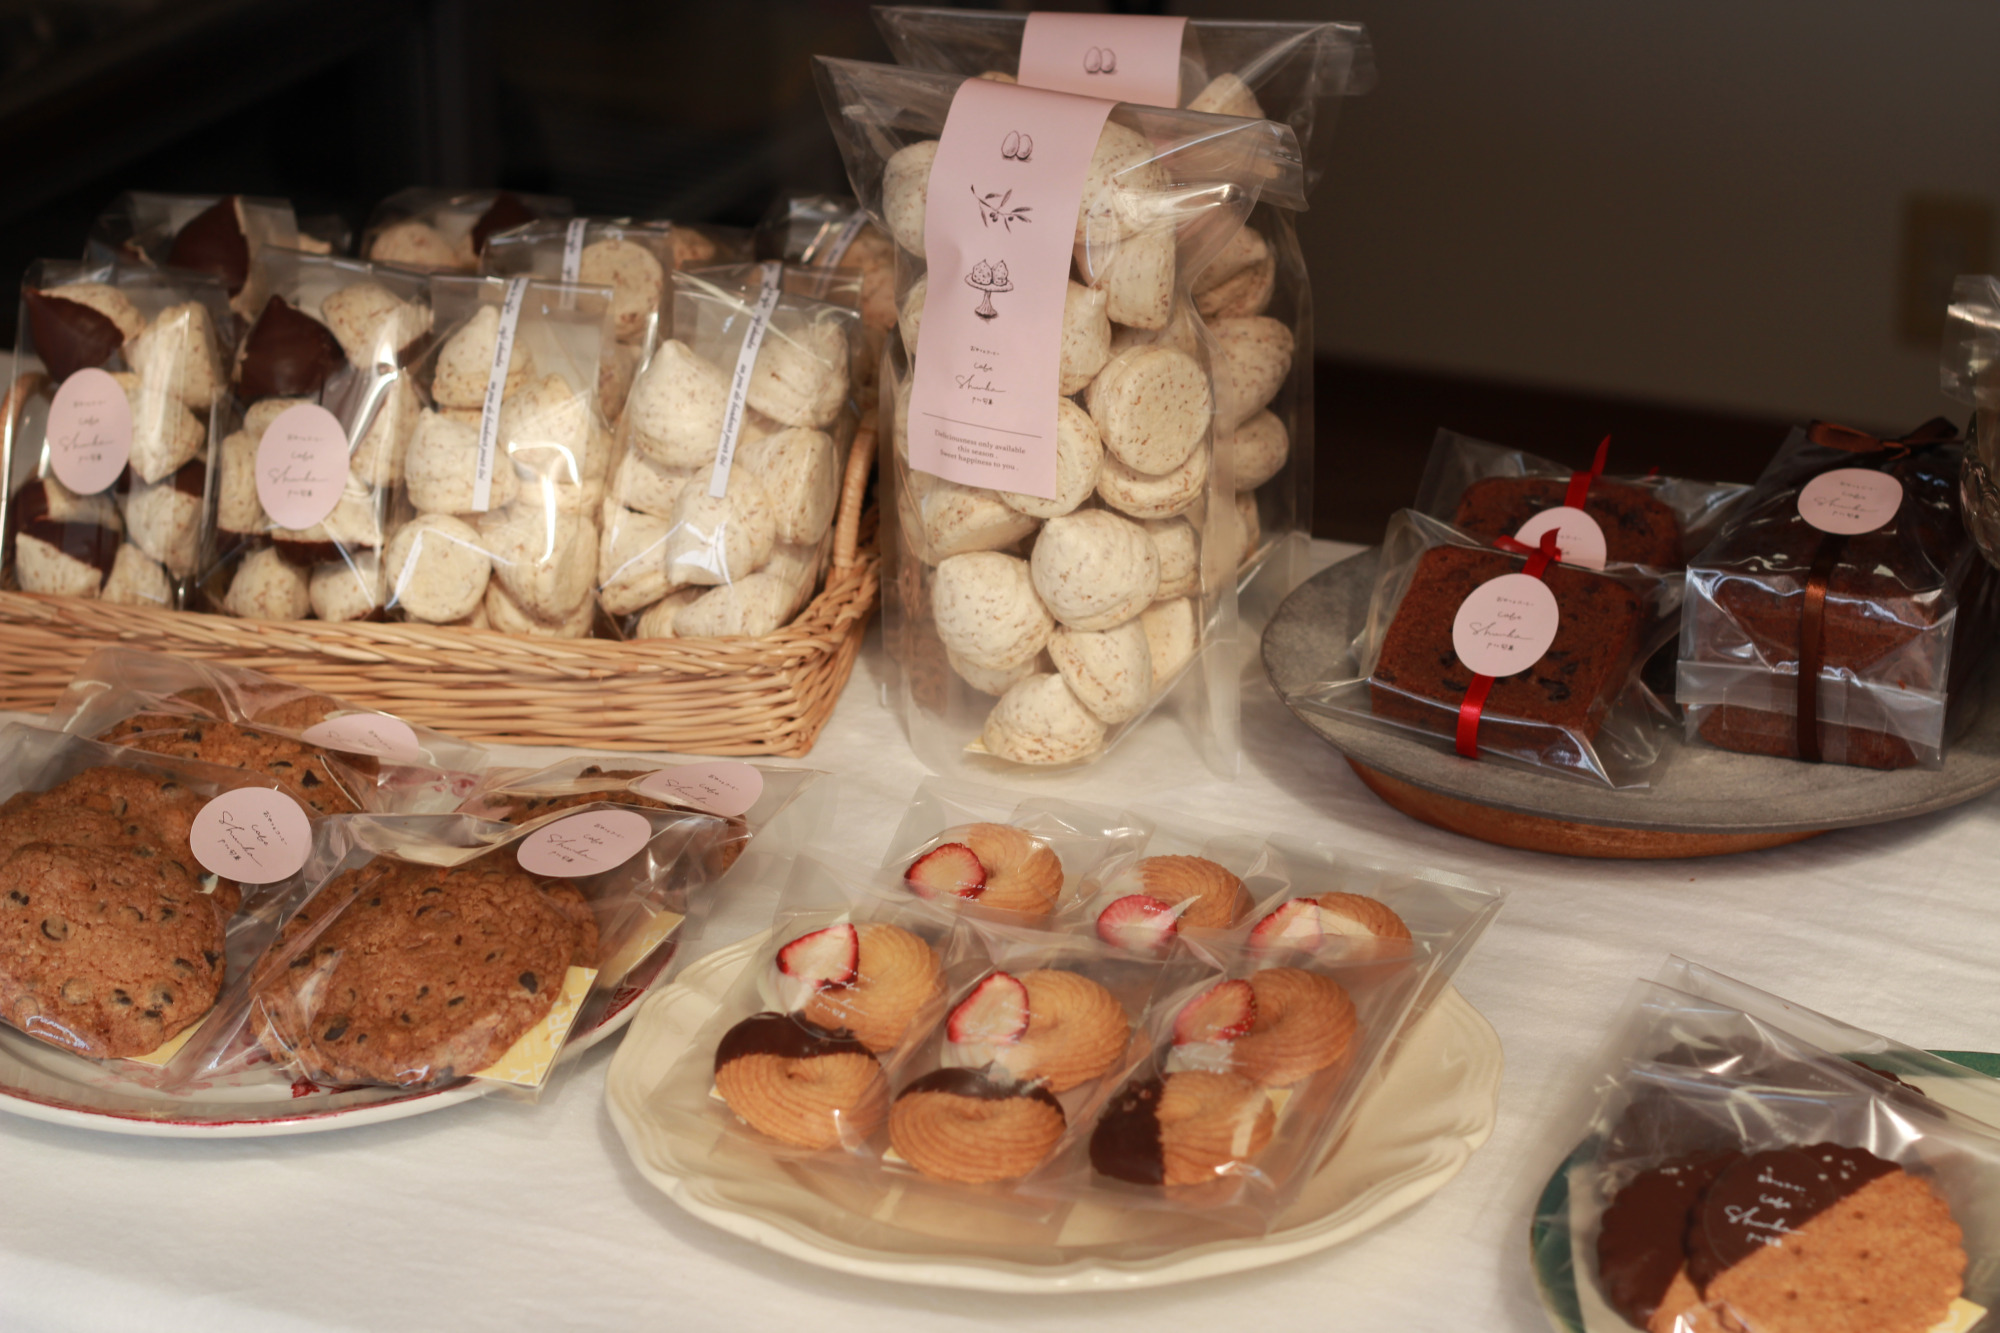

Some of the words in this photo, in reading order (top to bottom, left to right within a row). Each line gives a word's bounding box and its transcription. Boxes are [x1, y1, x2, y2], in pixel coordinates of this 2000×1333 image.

[934, 429, 977, 446] Deliciousness
[978, 440, 994, 450] only
[995, 443, 1026, 454] available
[957, 444, 970, 453] this
[940, 449, 957, 460] Sweet
[958, 454, 992, 467] happiness
[993, 460, 1001, 468] to
